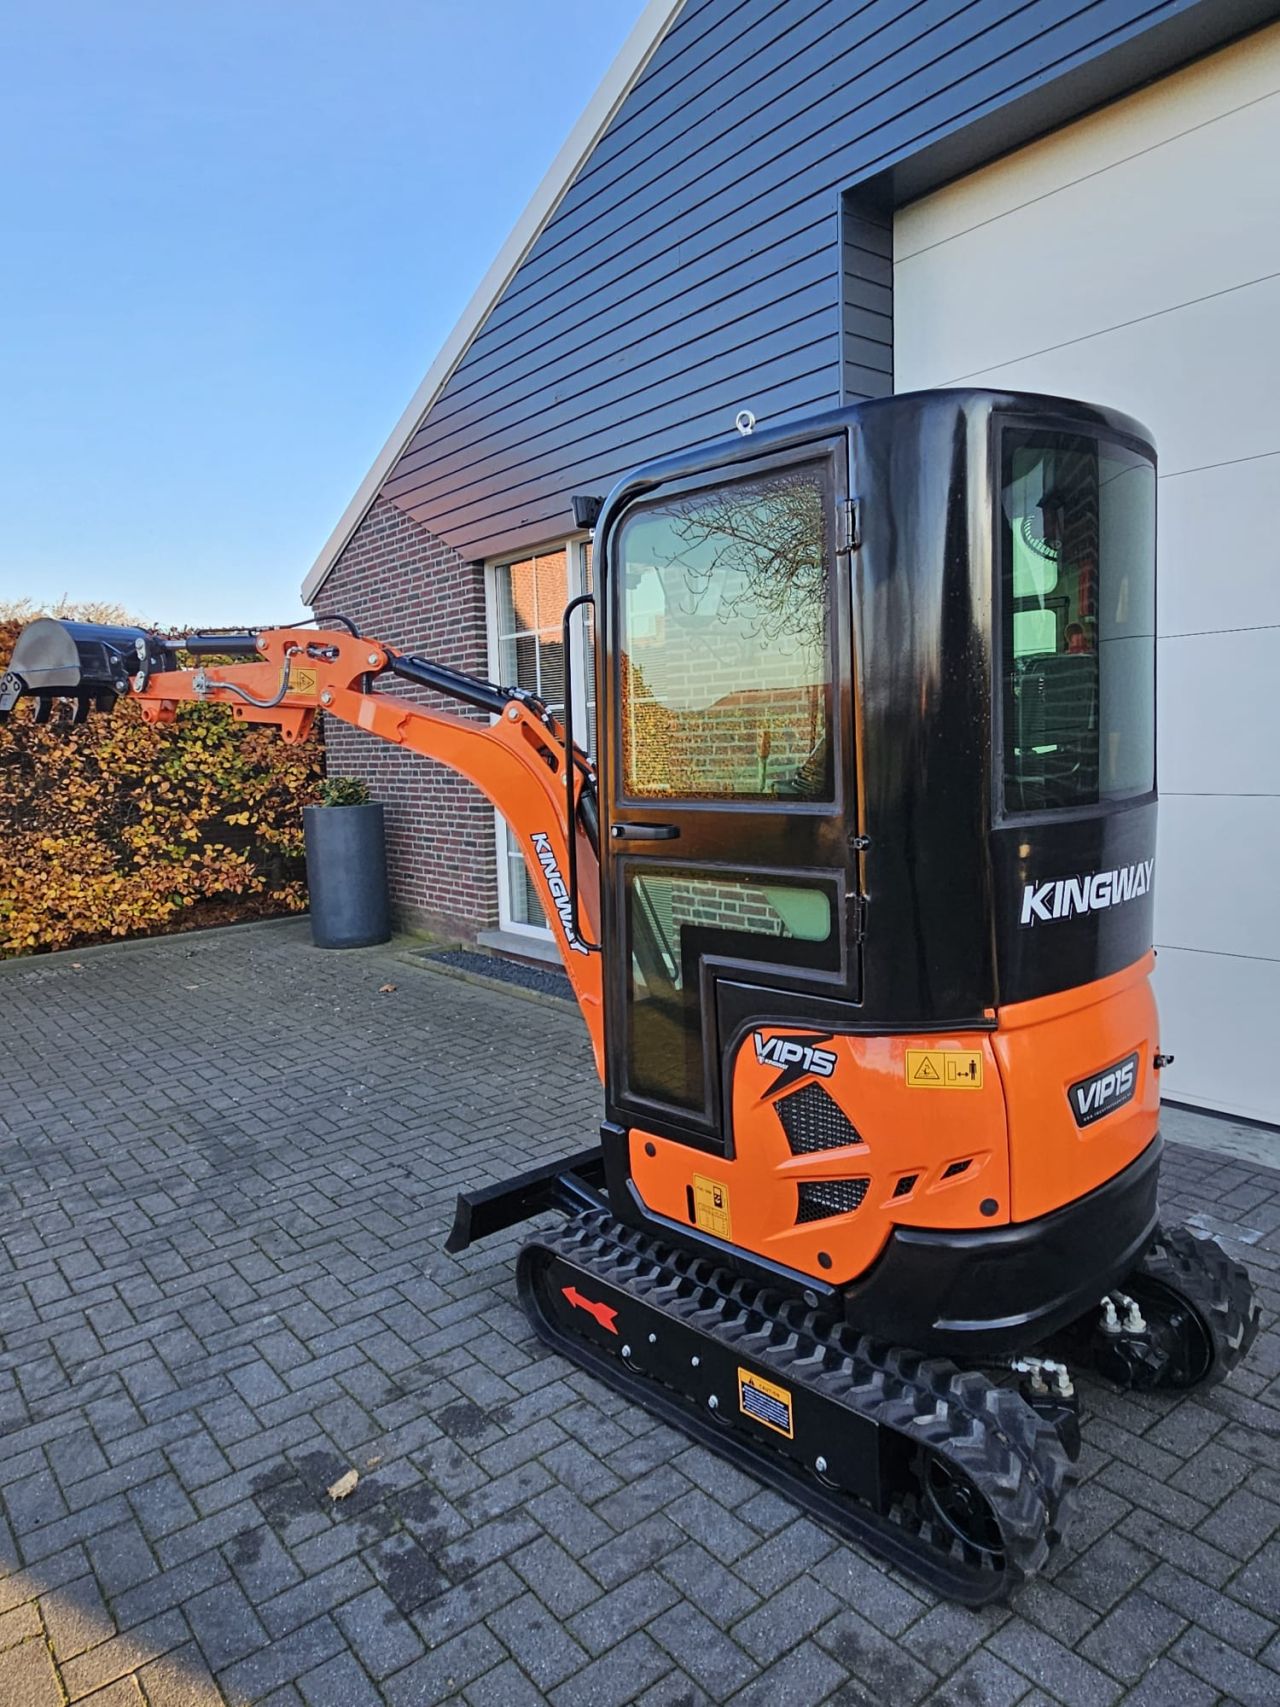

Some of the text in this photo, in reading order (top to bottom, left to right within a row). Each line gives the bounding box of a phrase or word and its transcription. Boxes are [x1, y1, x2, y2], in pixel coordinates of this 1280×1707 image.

[1020, 858, 1154, 924] KINGWAY
[754, 1033, 836, 1076] VIP15
[1077, 1062, 1134, 1114] VIP15
